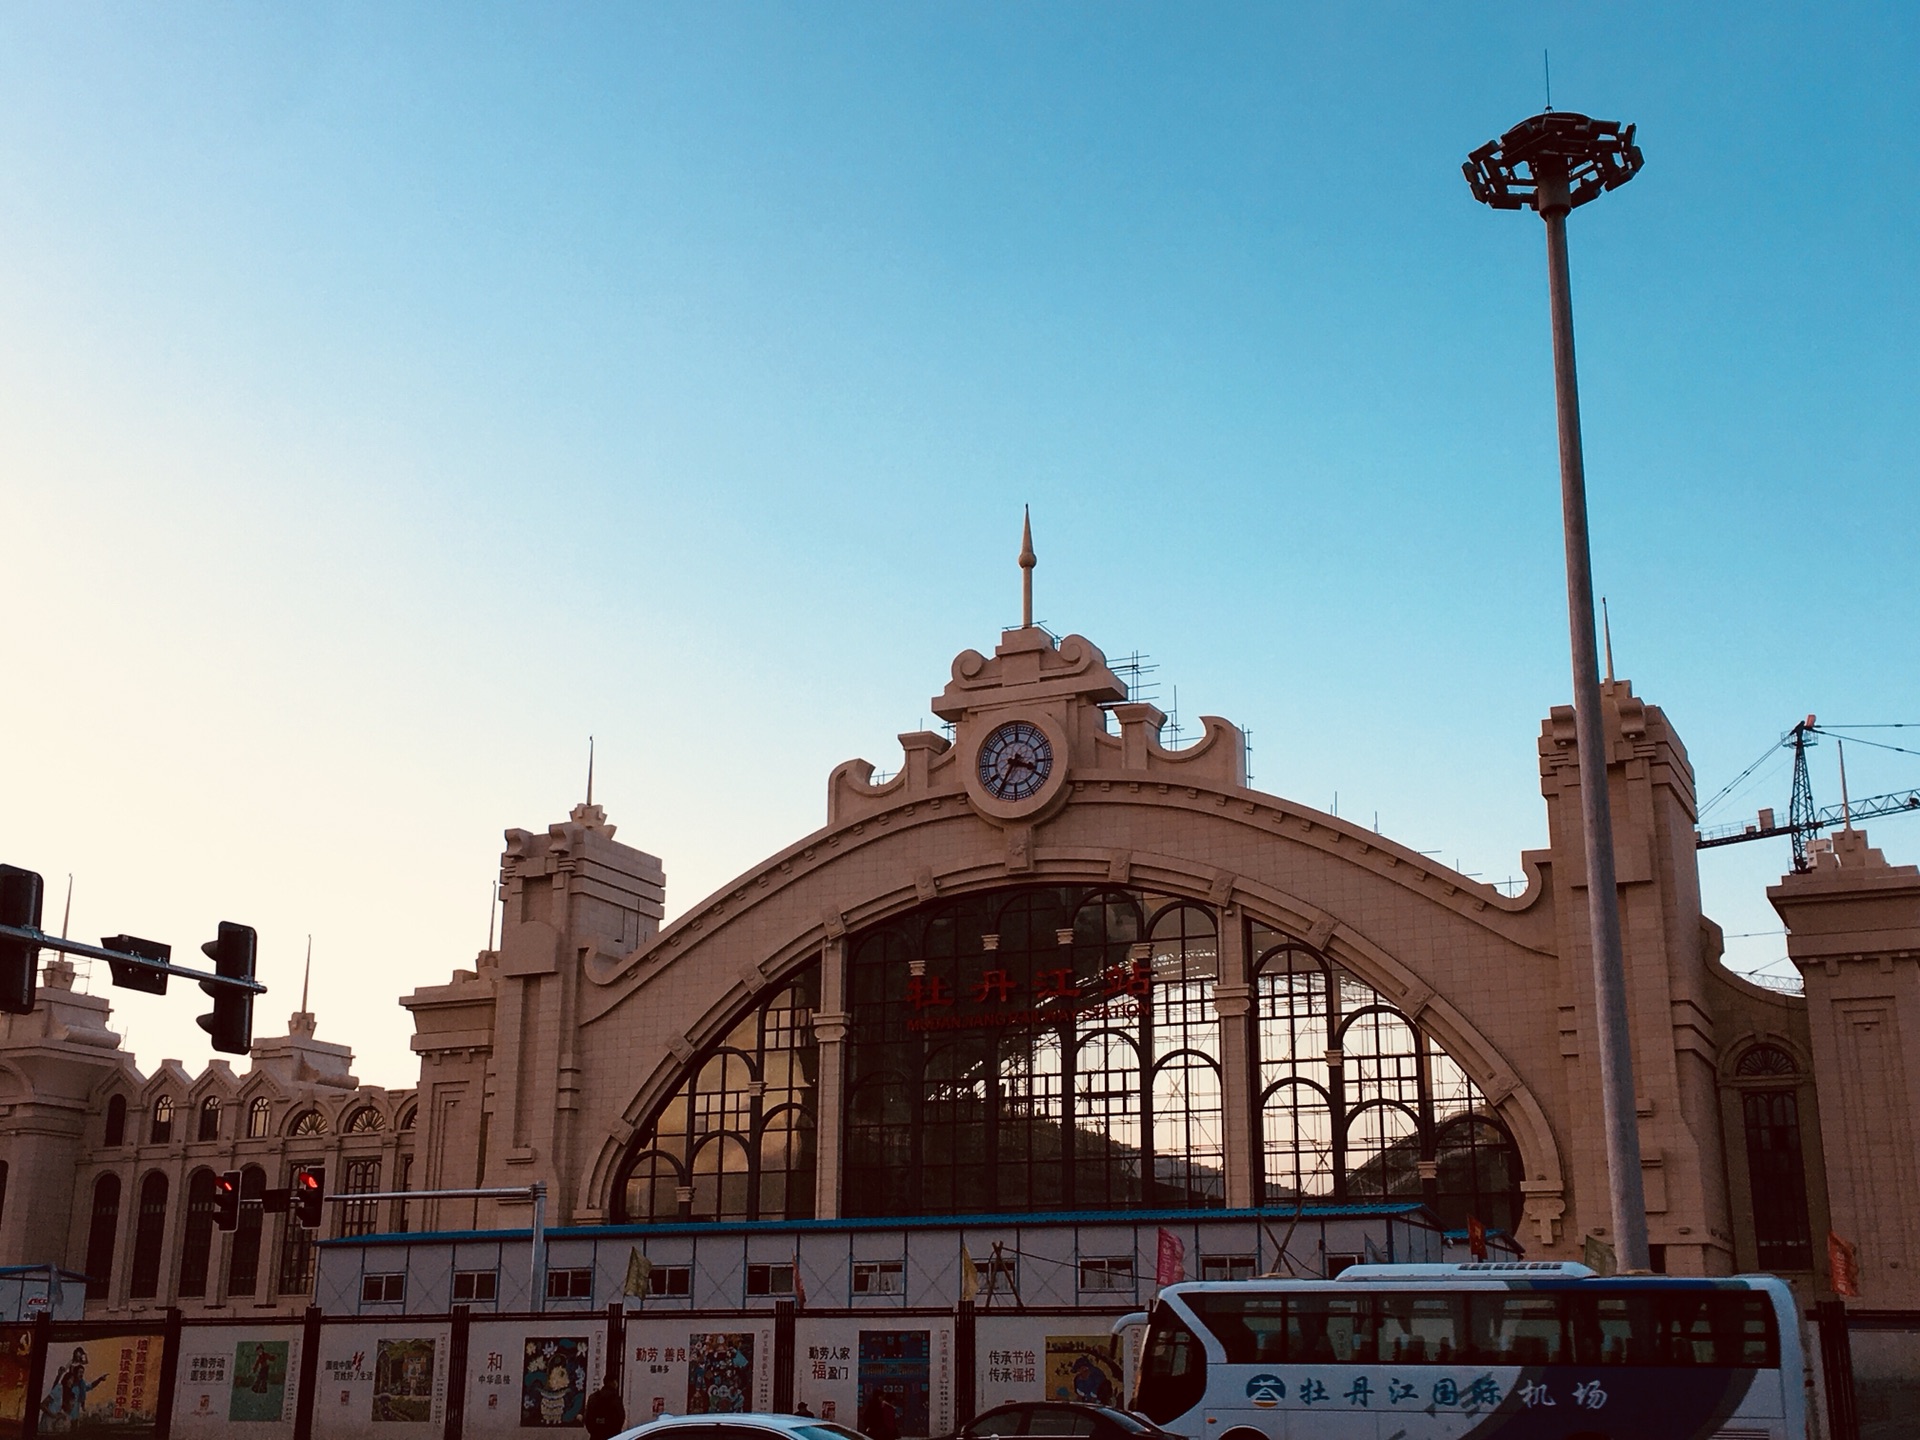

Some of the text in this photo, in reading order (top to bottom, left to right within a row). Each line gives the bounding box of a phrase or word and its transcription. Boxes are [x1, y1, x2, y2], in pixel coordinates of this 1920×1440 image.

[906, 961, 1151, 1010] 牡丹江站
[808, 1346, 850, 1360] 勤劳人家
[988, 1350, 1036, 1365] 传承节俭
[487, 1352, 503, 1372] 和
[812, 1361, 849, 1380] 福盈门
[478, 1374, 512, 1385] 中华品格
[988, 1367, 1036, 1383] 传承福报
[1299, 1376, 1609, 1411] 牡丹江国际机场
